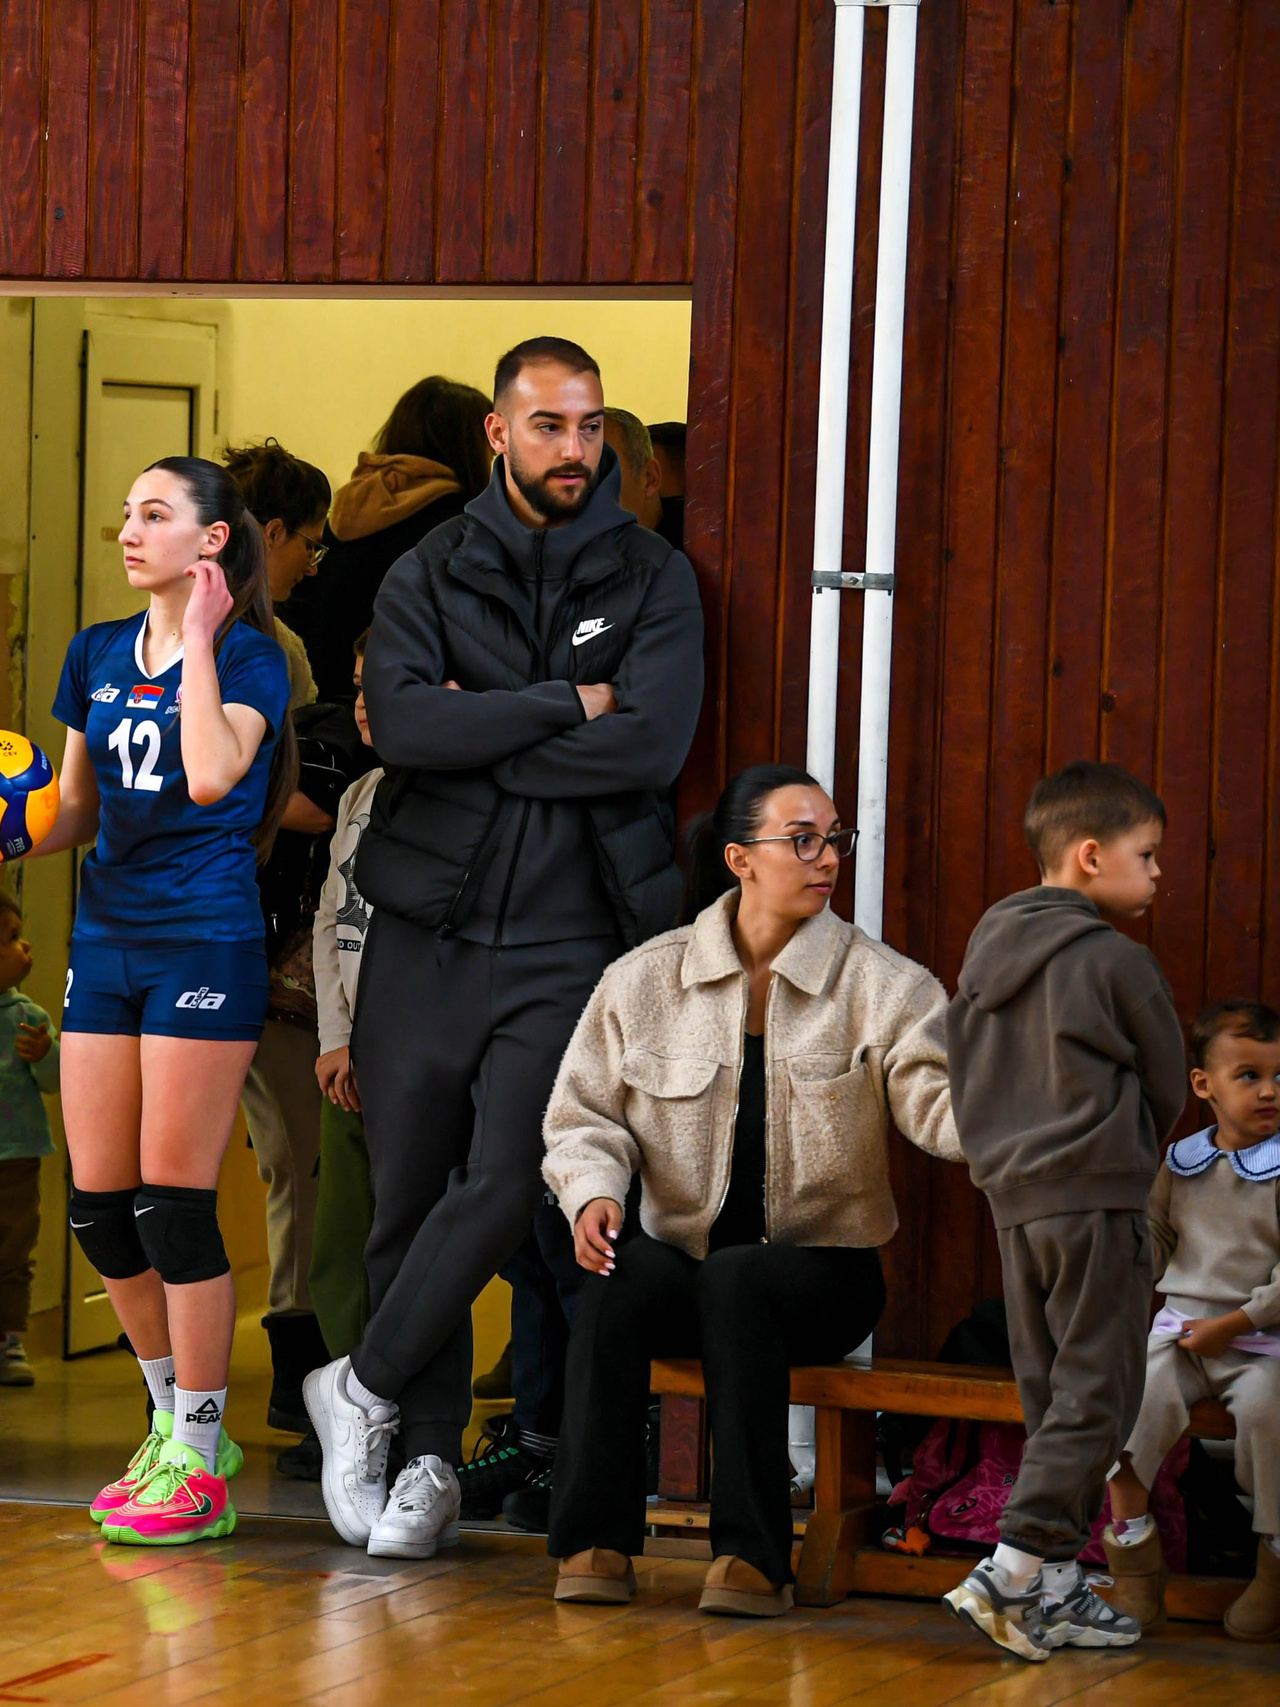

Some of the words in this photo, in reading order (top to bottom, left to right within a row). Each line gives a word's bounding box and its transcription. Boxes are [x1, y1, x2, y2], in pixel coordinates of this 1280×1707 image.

[576, 617, 605, 635] NIKE
[108, 718, 164, 792] 12
[185, 1412, 222, 1424] PEAK
